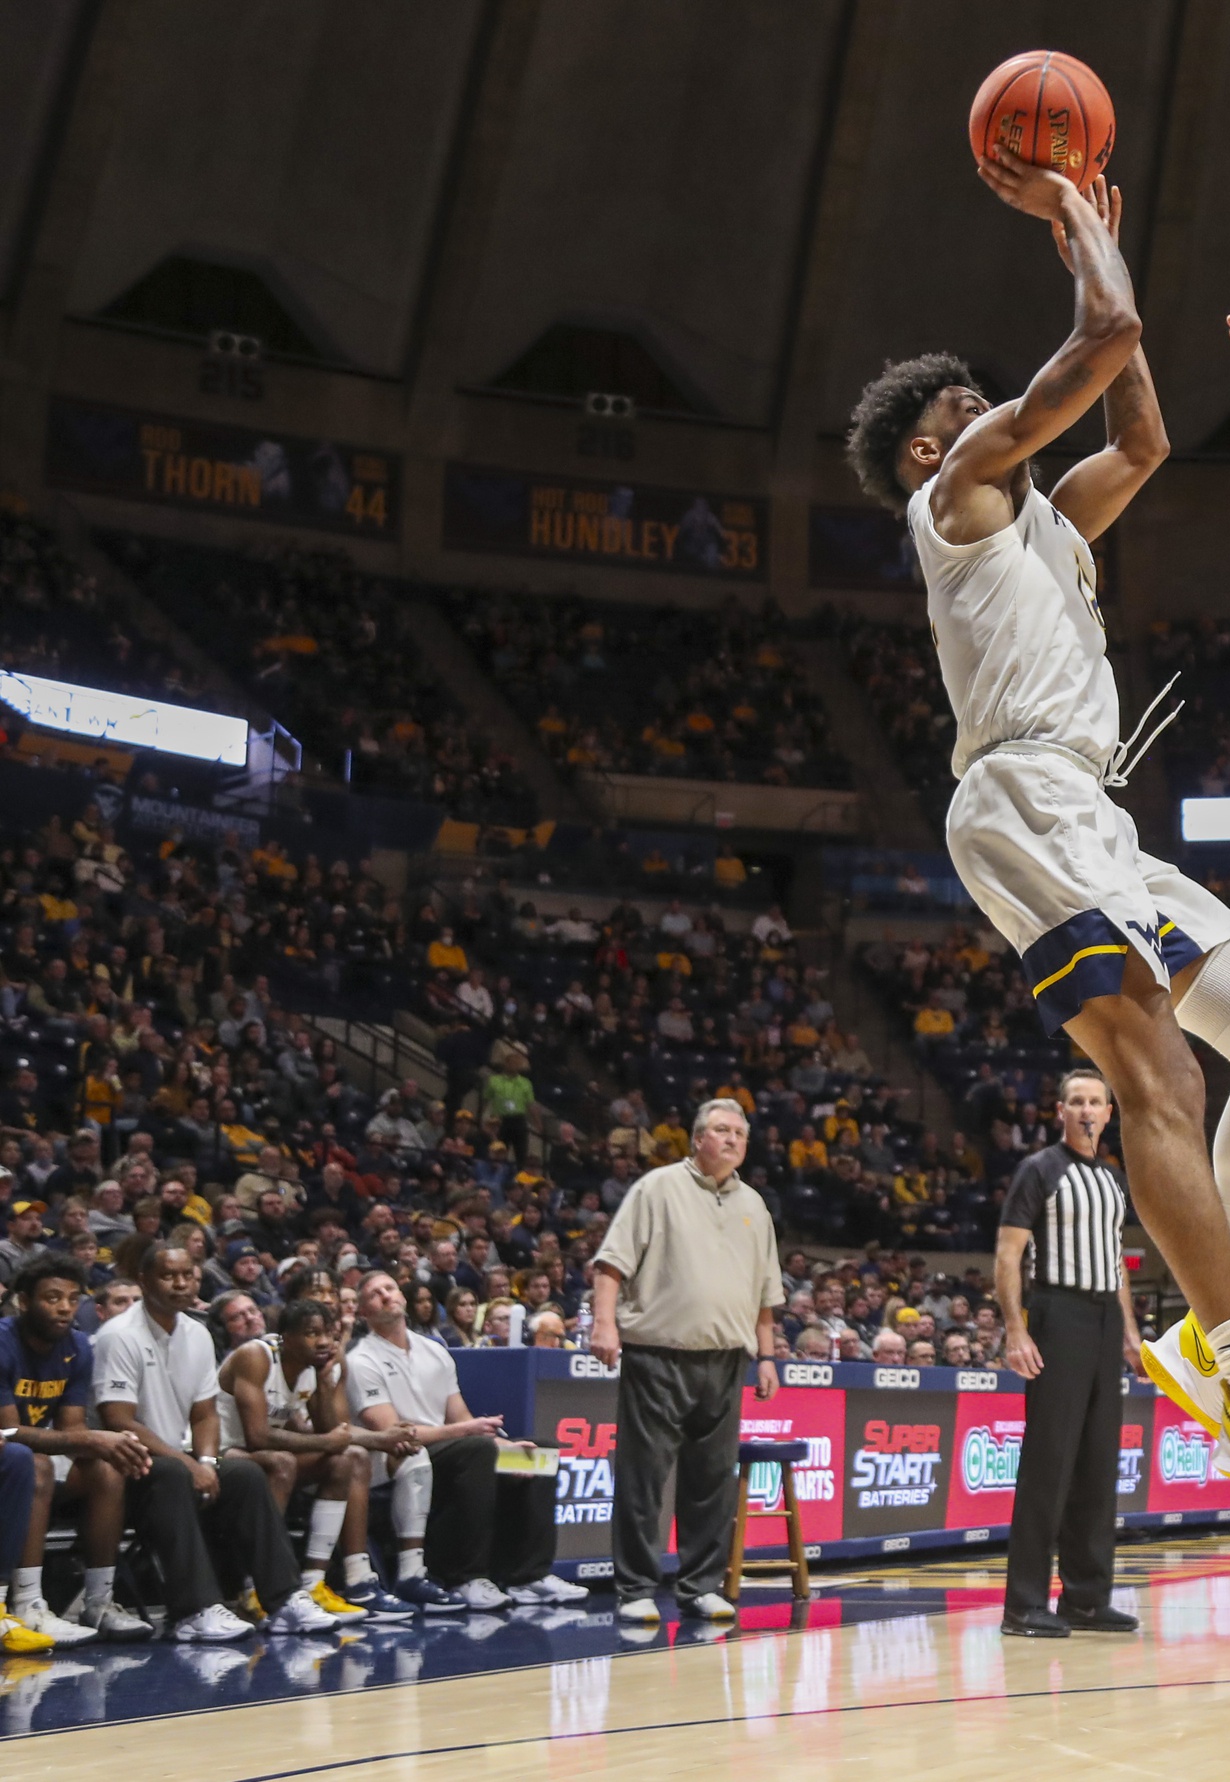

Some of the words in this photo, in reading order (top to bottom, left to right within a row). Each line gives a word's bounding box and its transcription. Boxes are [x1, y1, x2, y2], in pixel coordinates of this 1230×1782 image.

[1048, 107, 1070, 174] SPALD
[142, 450, 263, 506] THORN
[344, 484, 388, 528] 44
[530, 508, 681, 560] HUNDLEY
[720, 529, 758, 569] 33
[570, 1354, 621, 1378] GEIC
[784, 1364, 833, 1386] GEICO
[874, 1368, 920, 1389] GEICO
[957, 1371, 998, 1391] GEICO
[556, 1417, 618, 1458] SUP
[791, 1436, 831, 1468] UTO
[863, 1420, 940, 1453] SUPER
[851, 1449, 941, 1488] START
[964, 1429, 1021, 1489] O'Reill
[1160, 1428, 1210, 1486] O'Reilly
[556, 1457, 614, 1498] STA
[793, 1470, 834, 1500] ARTS
[555, 1502, 614, 1524] BATTE
[859, 1488, 930, 1508] BATTERIES
[881, 1537, 910, 1552] GEICO
[964, 1529, 989, 1542] GEICO
